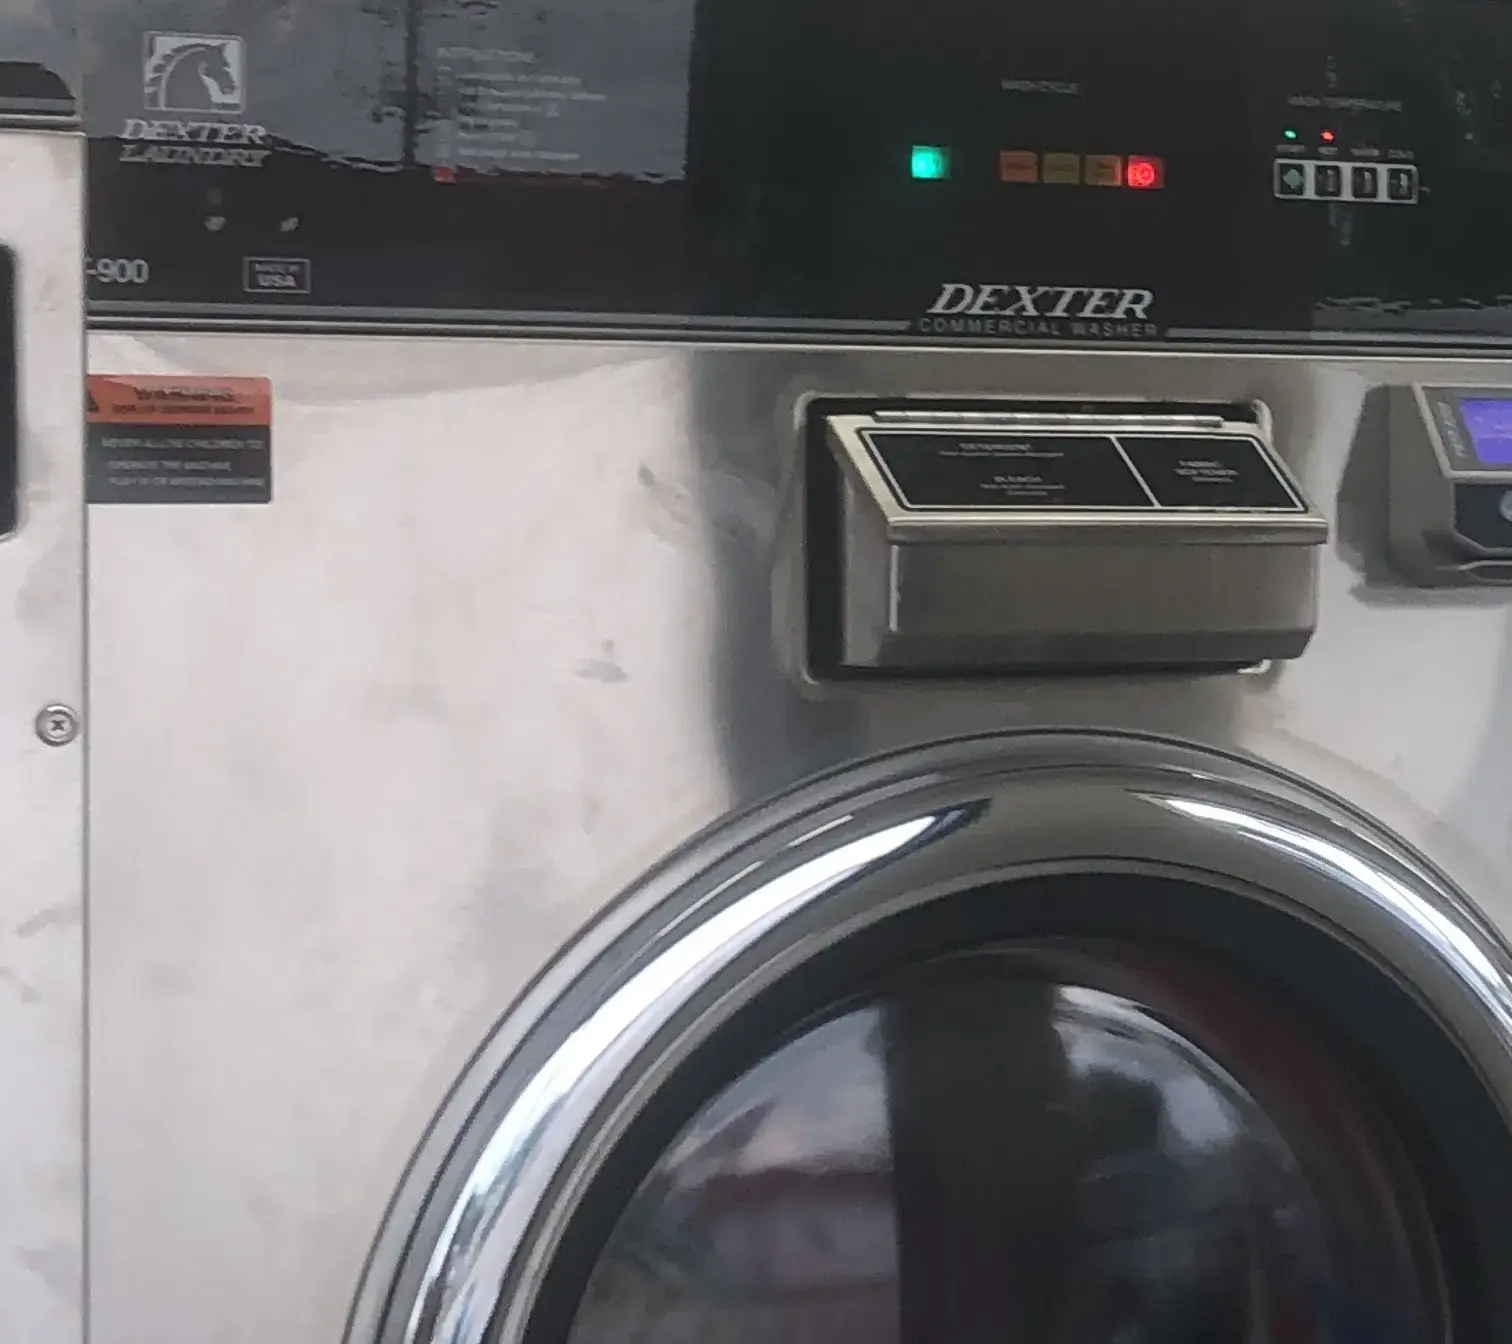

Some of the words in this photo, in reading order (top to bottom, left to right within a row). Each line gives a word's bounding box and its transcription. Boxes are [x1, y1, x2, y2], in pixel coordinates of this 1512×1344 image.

[119, 118, 267, 145] DEXTER
[119, 144, 271, 168] LAUNDRY
[84, 256, 150, 284] -900
[926, 283, 1154, 319] DEXTER
[918, 317, 1061, 337] COMMERCIAL
[1070, 321, 1159, 338] WASHER
